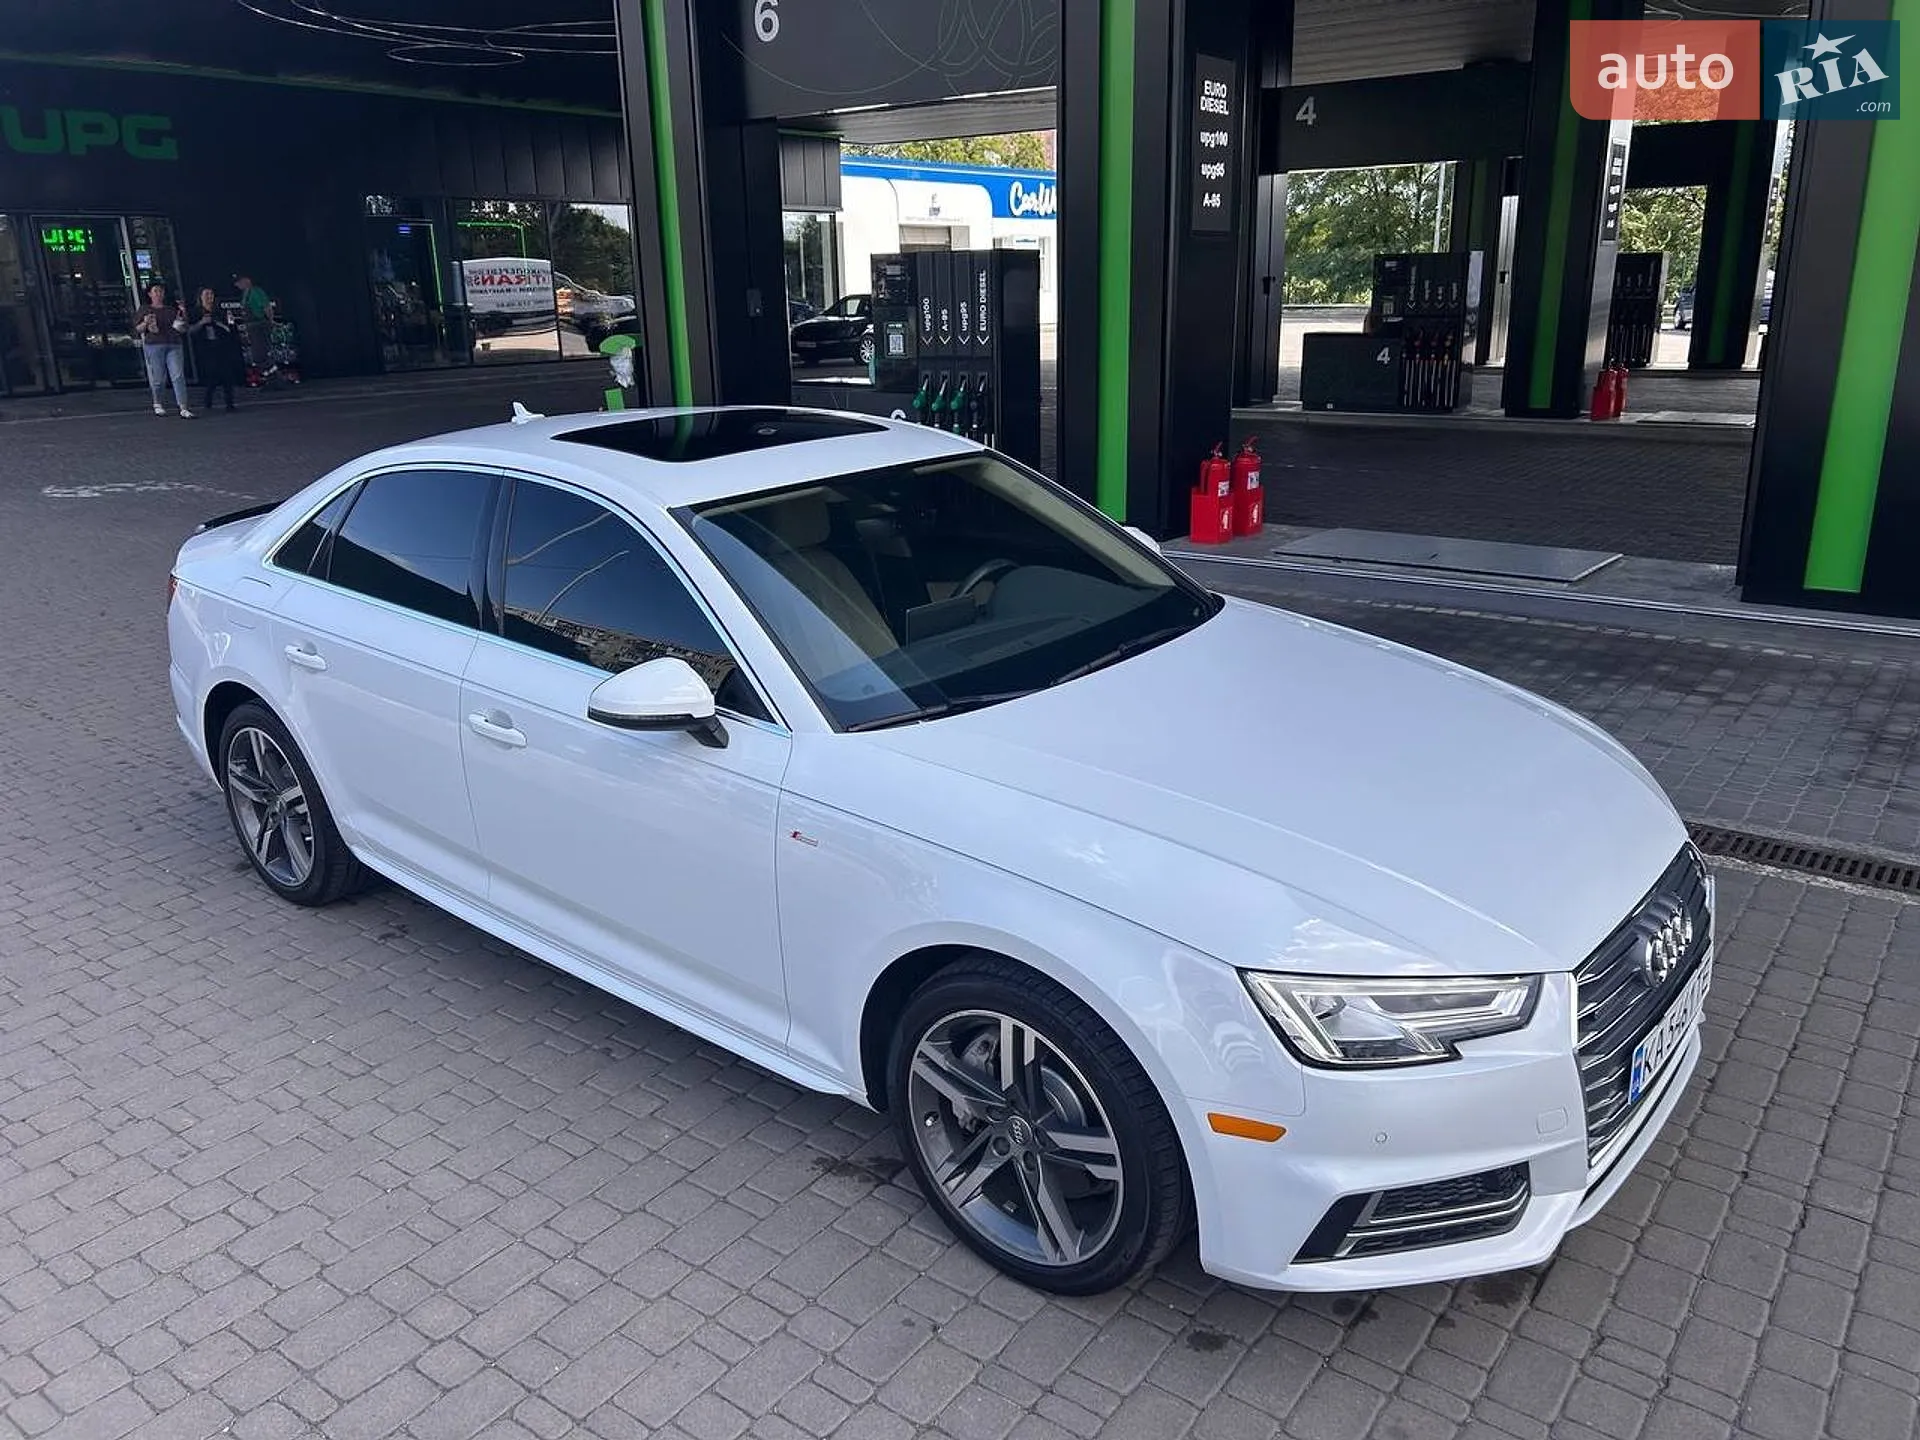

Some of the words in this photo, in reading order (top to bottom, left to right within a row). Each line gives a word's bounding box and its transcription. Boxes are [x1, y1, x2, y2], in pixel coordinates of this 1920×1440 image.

[755, 0, 780, 42] 6
[1204, 80, 1227, 98] EURO
[1200, 96, 1229, 115] DIESEL
[1295, 96, 1317, 125] 4
[1, 105, 179, 160] UPG
[1200, 131, 1228, 148] upg100
[979, 304, 987, 331] EURO
[1377, 347, 1391, 365] 4
